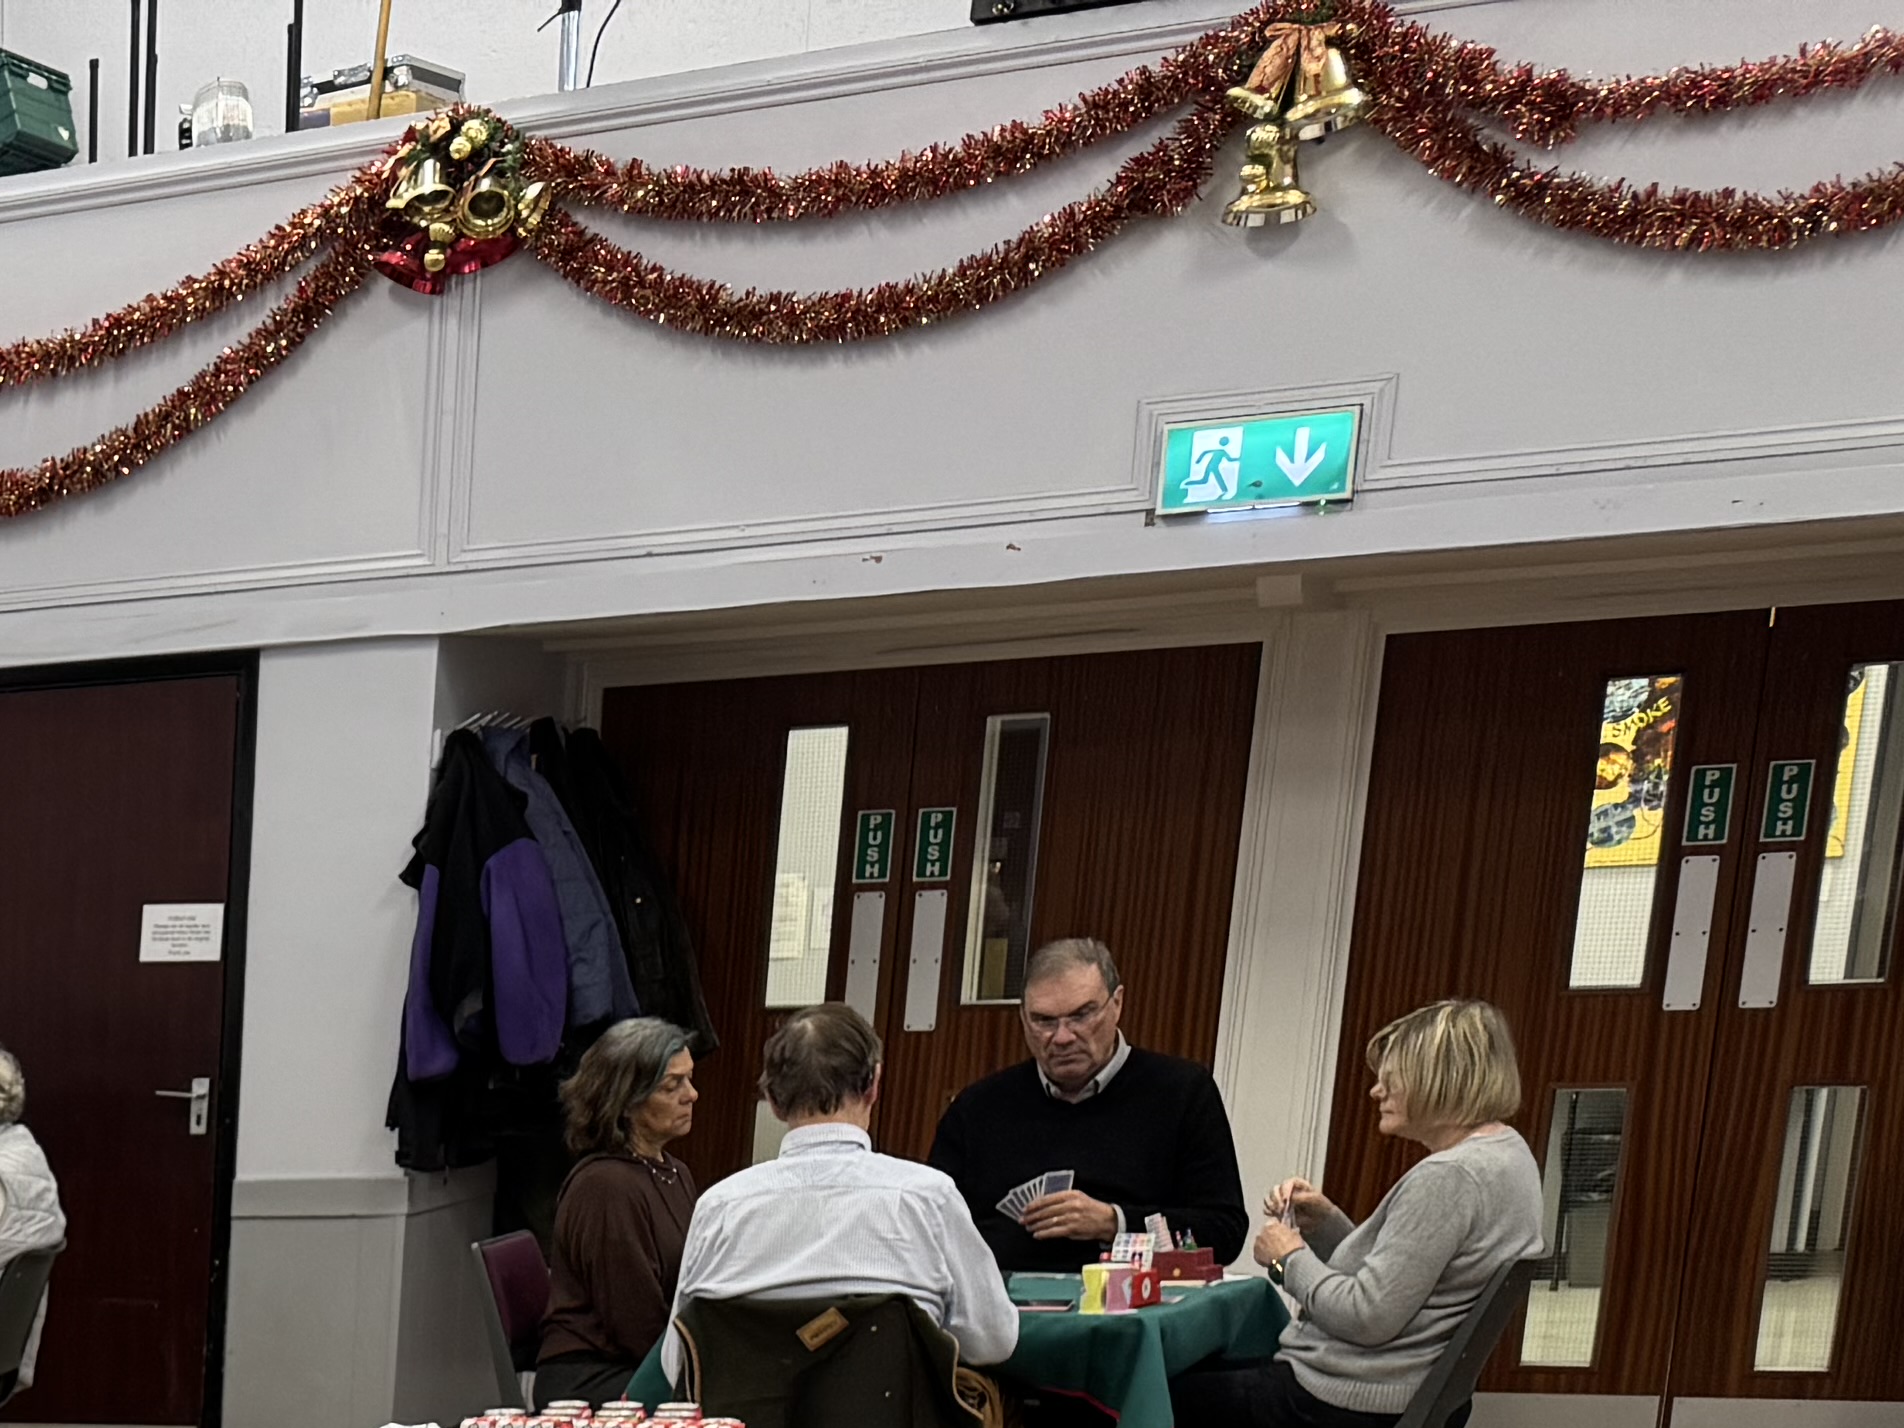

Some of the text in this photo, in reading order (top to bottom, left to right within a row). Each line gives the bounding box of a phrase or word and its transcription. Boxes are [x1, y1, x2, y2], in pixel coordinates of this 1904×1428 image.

[1612, 696, 1672, 738] SMOKE
[1697, 769, 1720, 841] PUSH
[1775, 765, 1798, 836] PUSH
[864, 814, 883, 878] PUSH
[924, 812, 943, 877] PUSH
